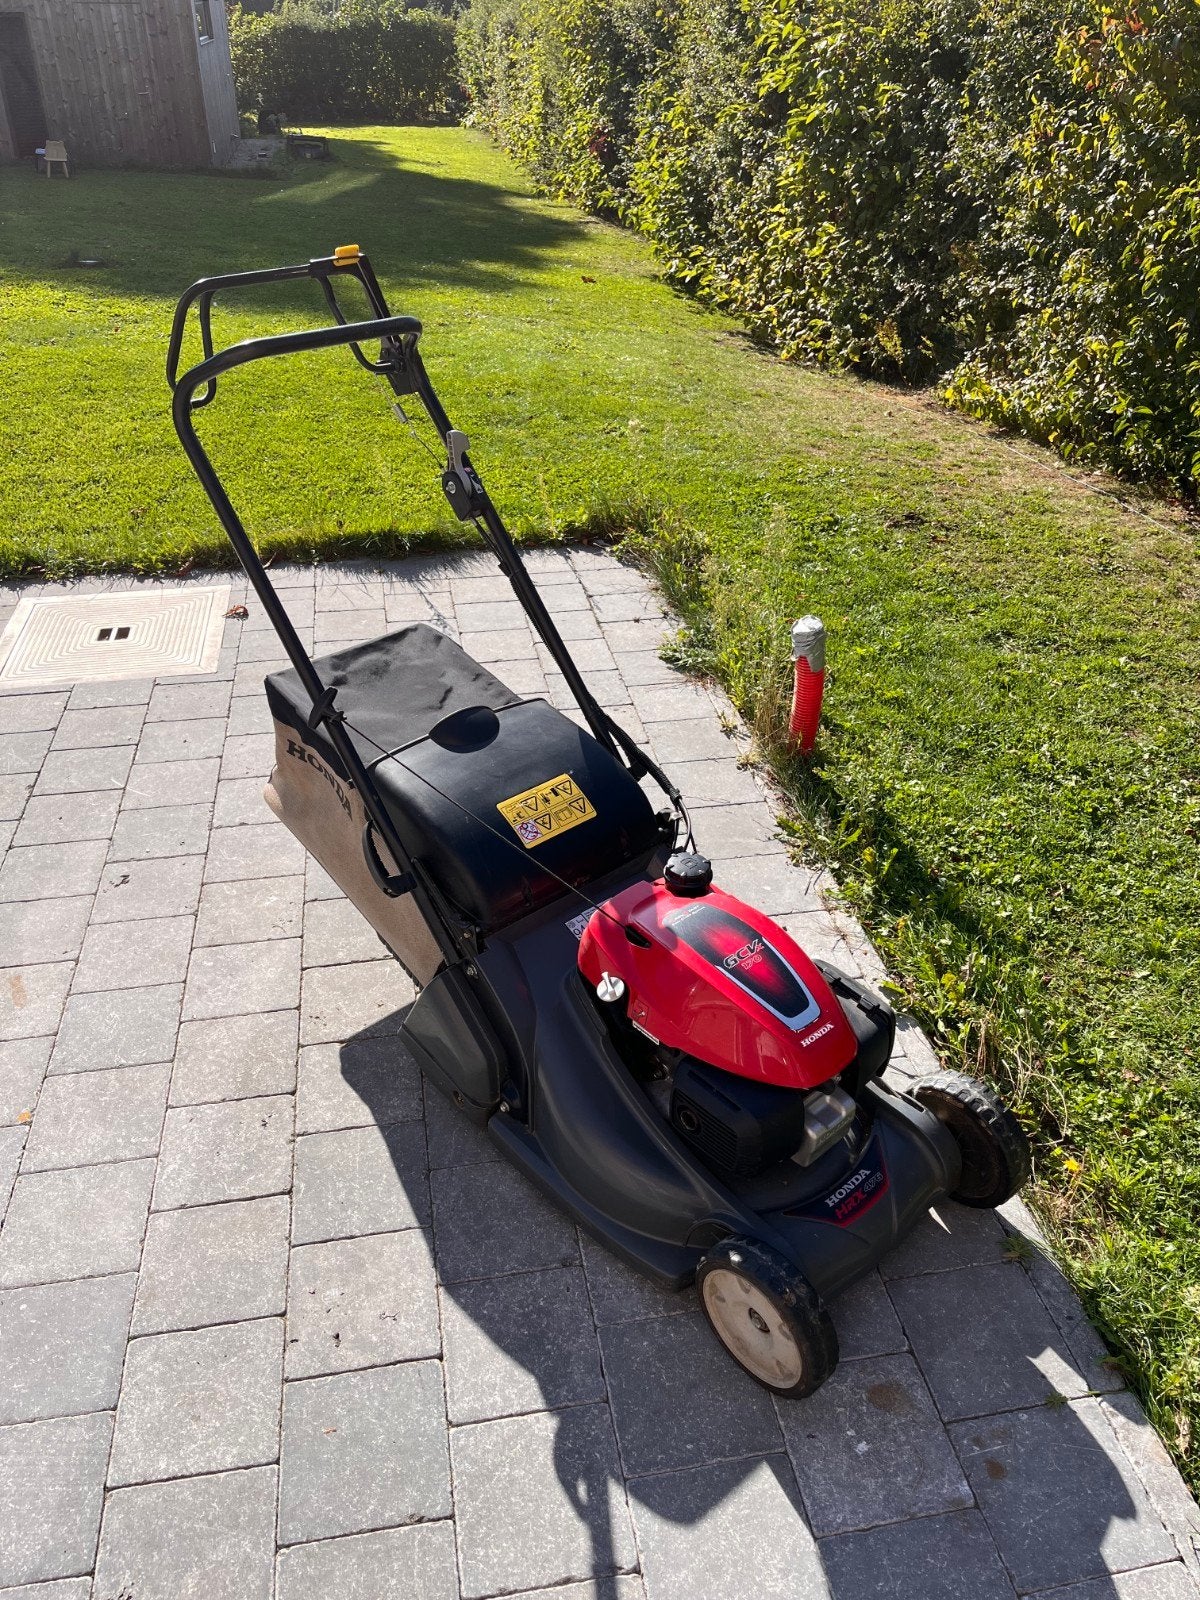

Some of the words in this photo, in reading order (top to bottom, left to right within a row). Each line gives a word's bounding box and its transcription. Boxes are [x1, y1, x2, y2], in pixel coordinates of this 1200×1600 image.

[286, 739, 353, 821] HONDA
[800, 1021, 835, 1048] HONDA
[824, 1169, 871, 1207] HONDA
